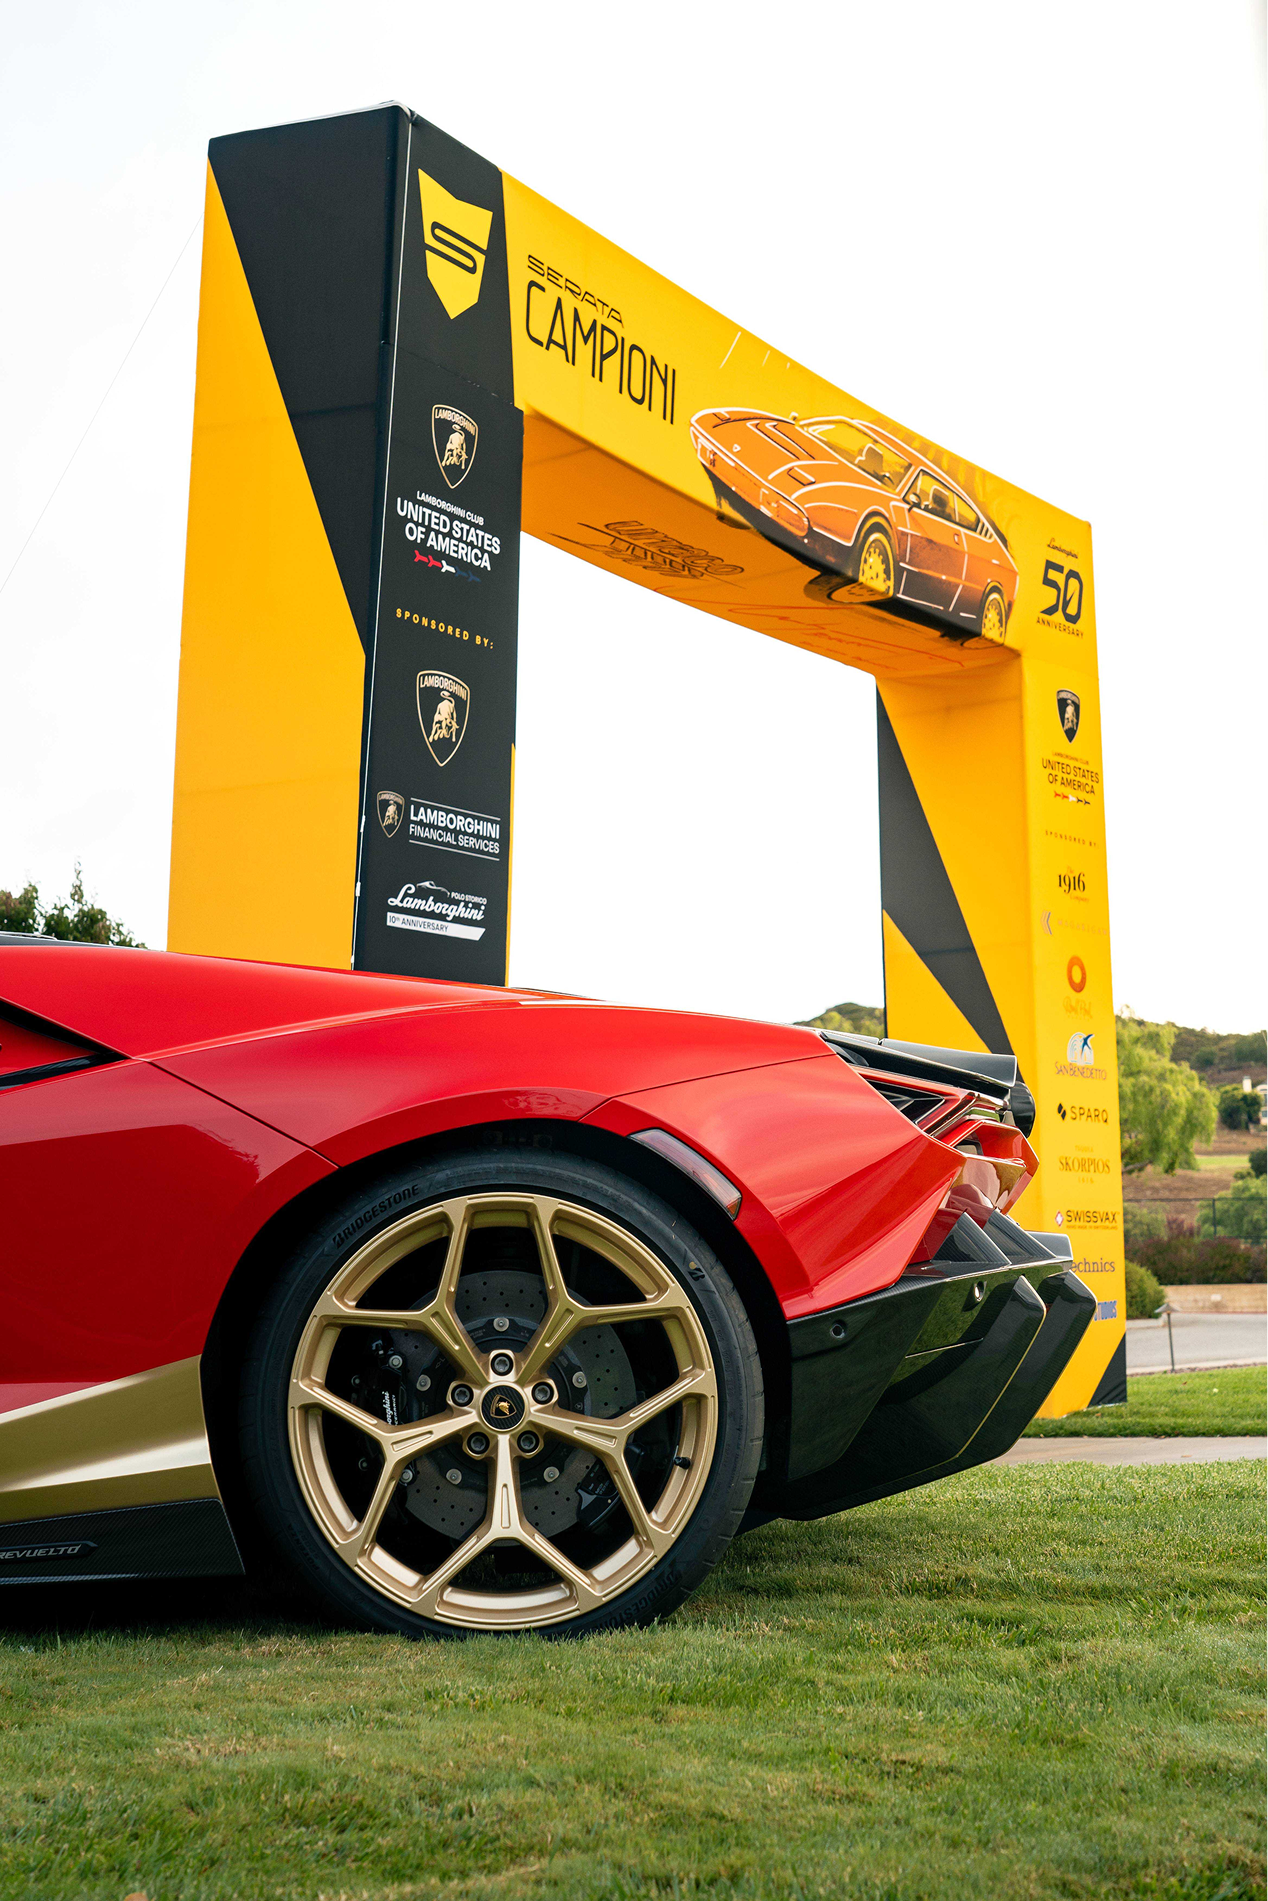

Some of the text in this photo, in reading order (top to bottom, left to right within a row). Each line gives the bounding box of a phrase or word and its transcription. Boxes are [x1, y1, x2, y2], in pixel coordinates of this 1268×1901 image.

[527, 254, 624, 329] SERATA
[525, 279, 676, 425] CAMPIONI
[434, 408, 476, 436] LAMBORGHINI
[416, 490, 485, 526] LAMBORGHINI CLUB
[396, 497, 501, 555] UNITED STATES
[404, 522, 492, 571] OF AMERICA
[1040, 559, 1084, 625] 50
[395, 608, 494, 650] SPONSORED BY:
[1036, 617, 1084, 639] ANNIVERSARY
[419, 675, 468, 701] LAMBORGHINI
[1041, 758, 1100, 784] UNITED STATES
[1047, 772, 1096, 796] OF AMERICA
[410, 804, 500, 839] LAMBORGHINI
[409, 824, 500, 854] FINANCIAL SERVICES
[1045, 830, 1086, 846] SPONSORED
[1058, 871, 1086, 894] 1916
[387, 883, 485, 921] Lamborghini
[451, 891, 488, 905] POLO STORICO
[401, 917, 449, 933] ANNIVERSARY
[1070, 1105, 1109, 1124] SPARQ
[1058, 1155, 1111, 1175] SKORPIOS
[332, 1184, 419, 1249] BRIDGESTONE
[1065, 1209, 1117, 1224] SWISSVAX
[1071, 1257, 1116, 1273] echnics
[0, 1544, 82, 1560] REVUELTO
